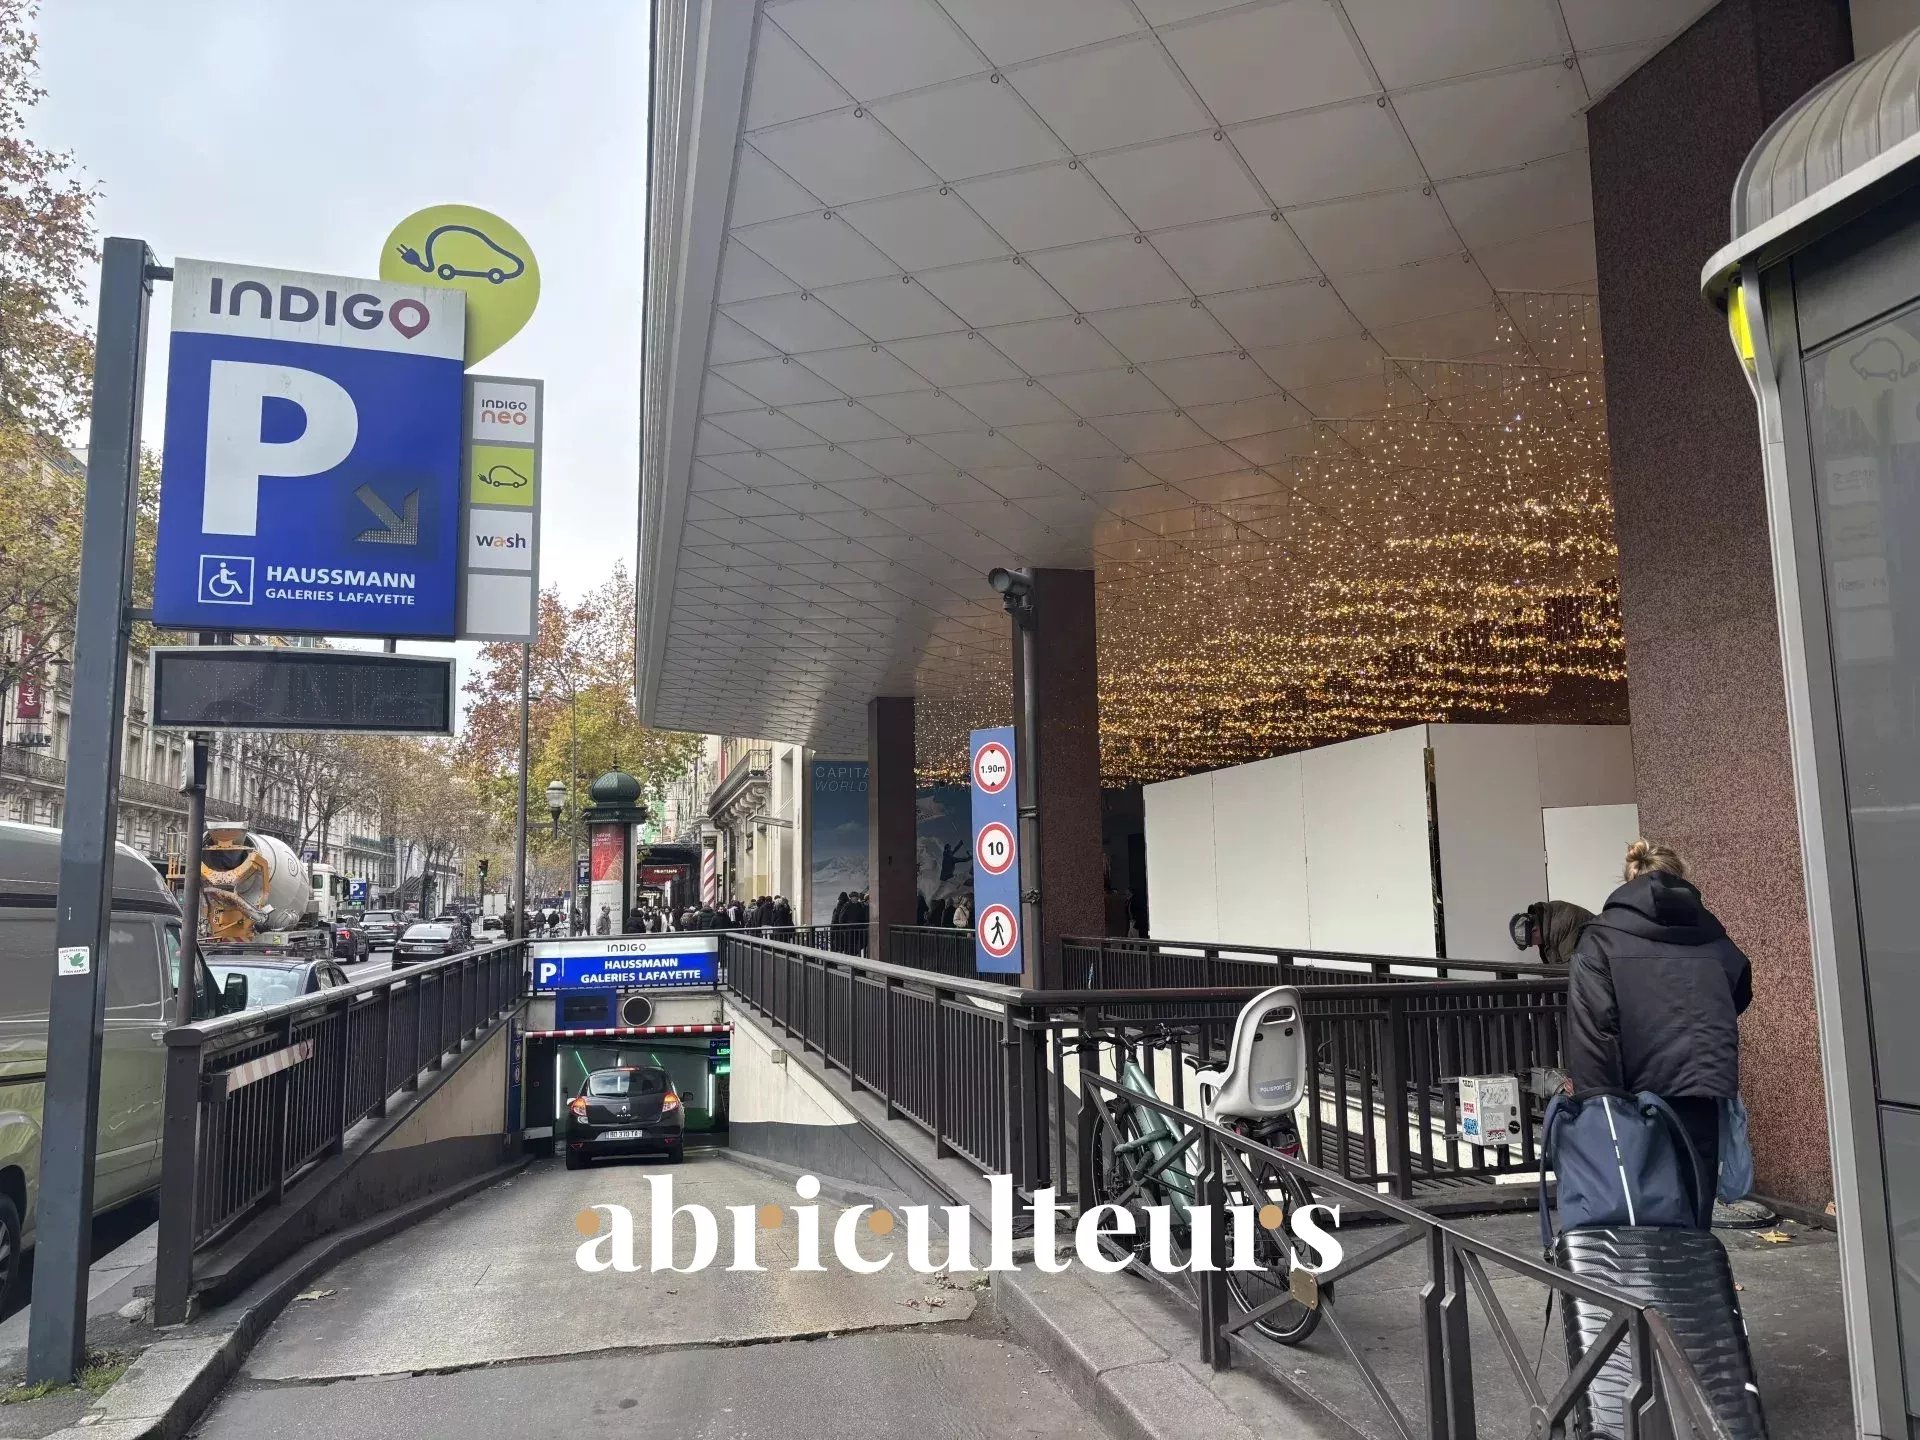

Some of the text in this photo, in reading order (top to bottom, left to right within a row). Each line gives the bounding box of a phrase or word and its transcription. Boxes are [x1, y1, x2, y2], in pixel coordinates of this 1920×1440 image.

[210, 278, 430, 339] INDIGO
[481, 399, 527, 411] INDIGO
[481, 410, 527, 425] neo
[202, 360, 358, 536] P
[476, 533, 526, 548] wash
[266, 565, 416, 589] HAUSSMANN
[265, 588, 415, 606] GALERIES LAFAYETTE
[815, 766, 870, 778] CAPITA
[980, 764, 1006, 774] 1.90m
[815, 780, 868, 792] WORLD
[987, 841, 1004, 856] 10
[350, 883, 360, 895] P
[607, 943, 647, 953] INDIGO
[604, 957, 678, 970] HAUSSMANN
[540, 962, 557, 984] P
[580, 969, 701, 984] GALERIES LAFAYETTE
